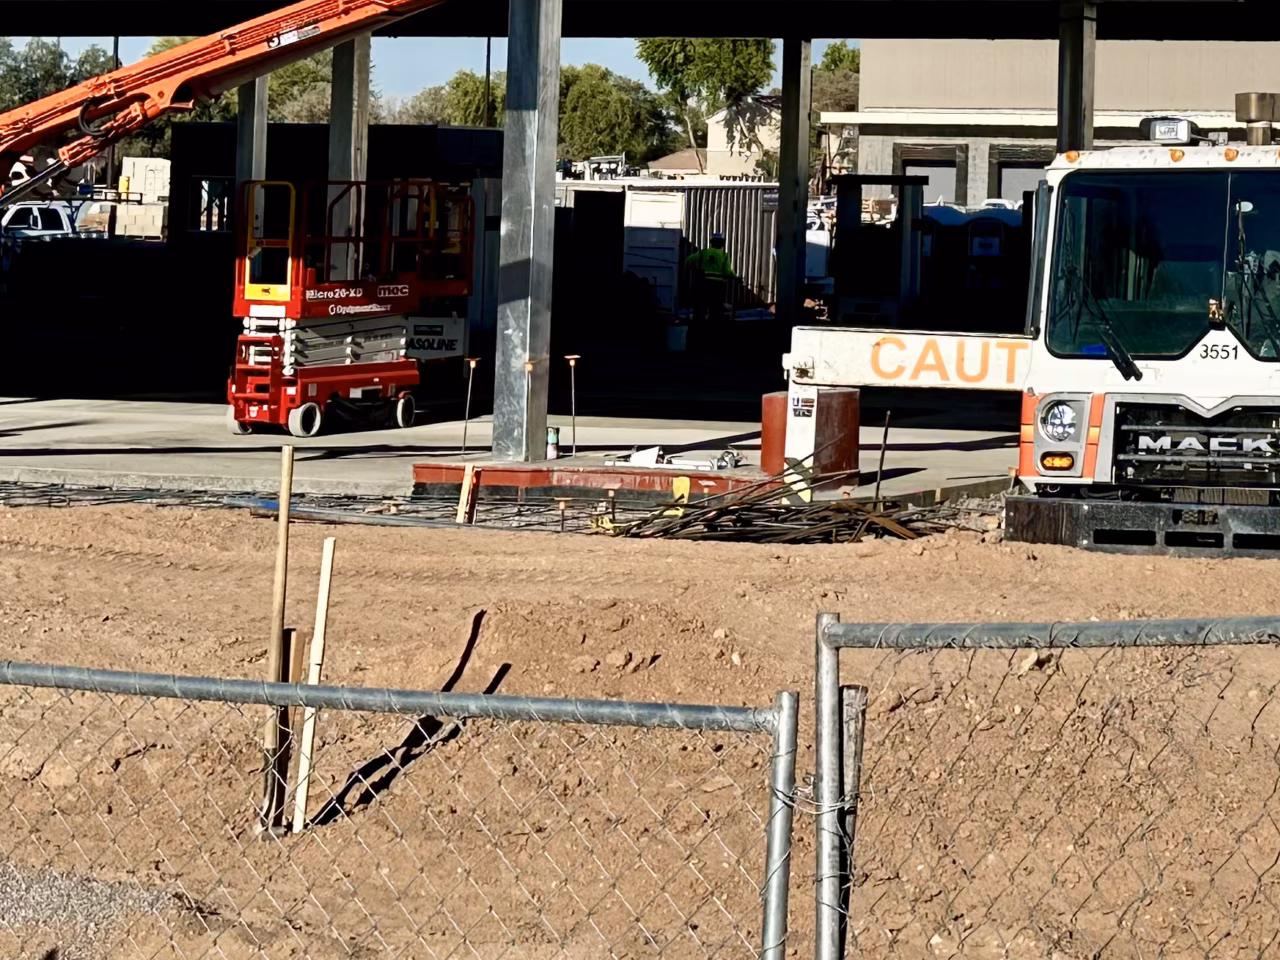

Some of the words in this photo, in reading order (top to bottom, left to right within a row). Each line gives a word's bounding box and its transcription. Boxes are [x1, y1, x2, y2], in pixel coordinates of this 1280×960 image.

[407, 338, 458, 352] ASOLINE
[1199, 344, 1239, 360] 3551
[870, 337, 1029, 384] CAUT
[1138, 435, 1278, 453] MACK
